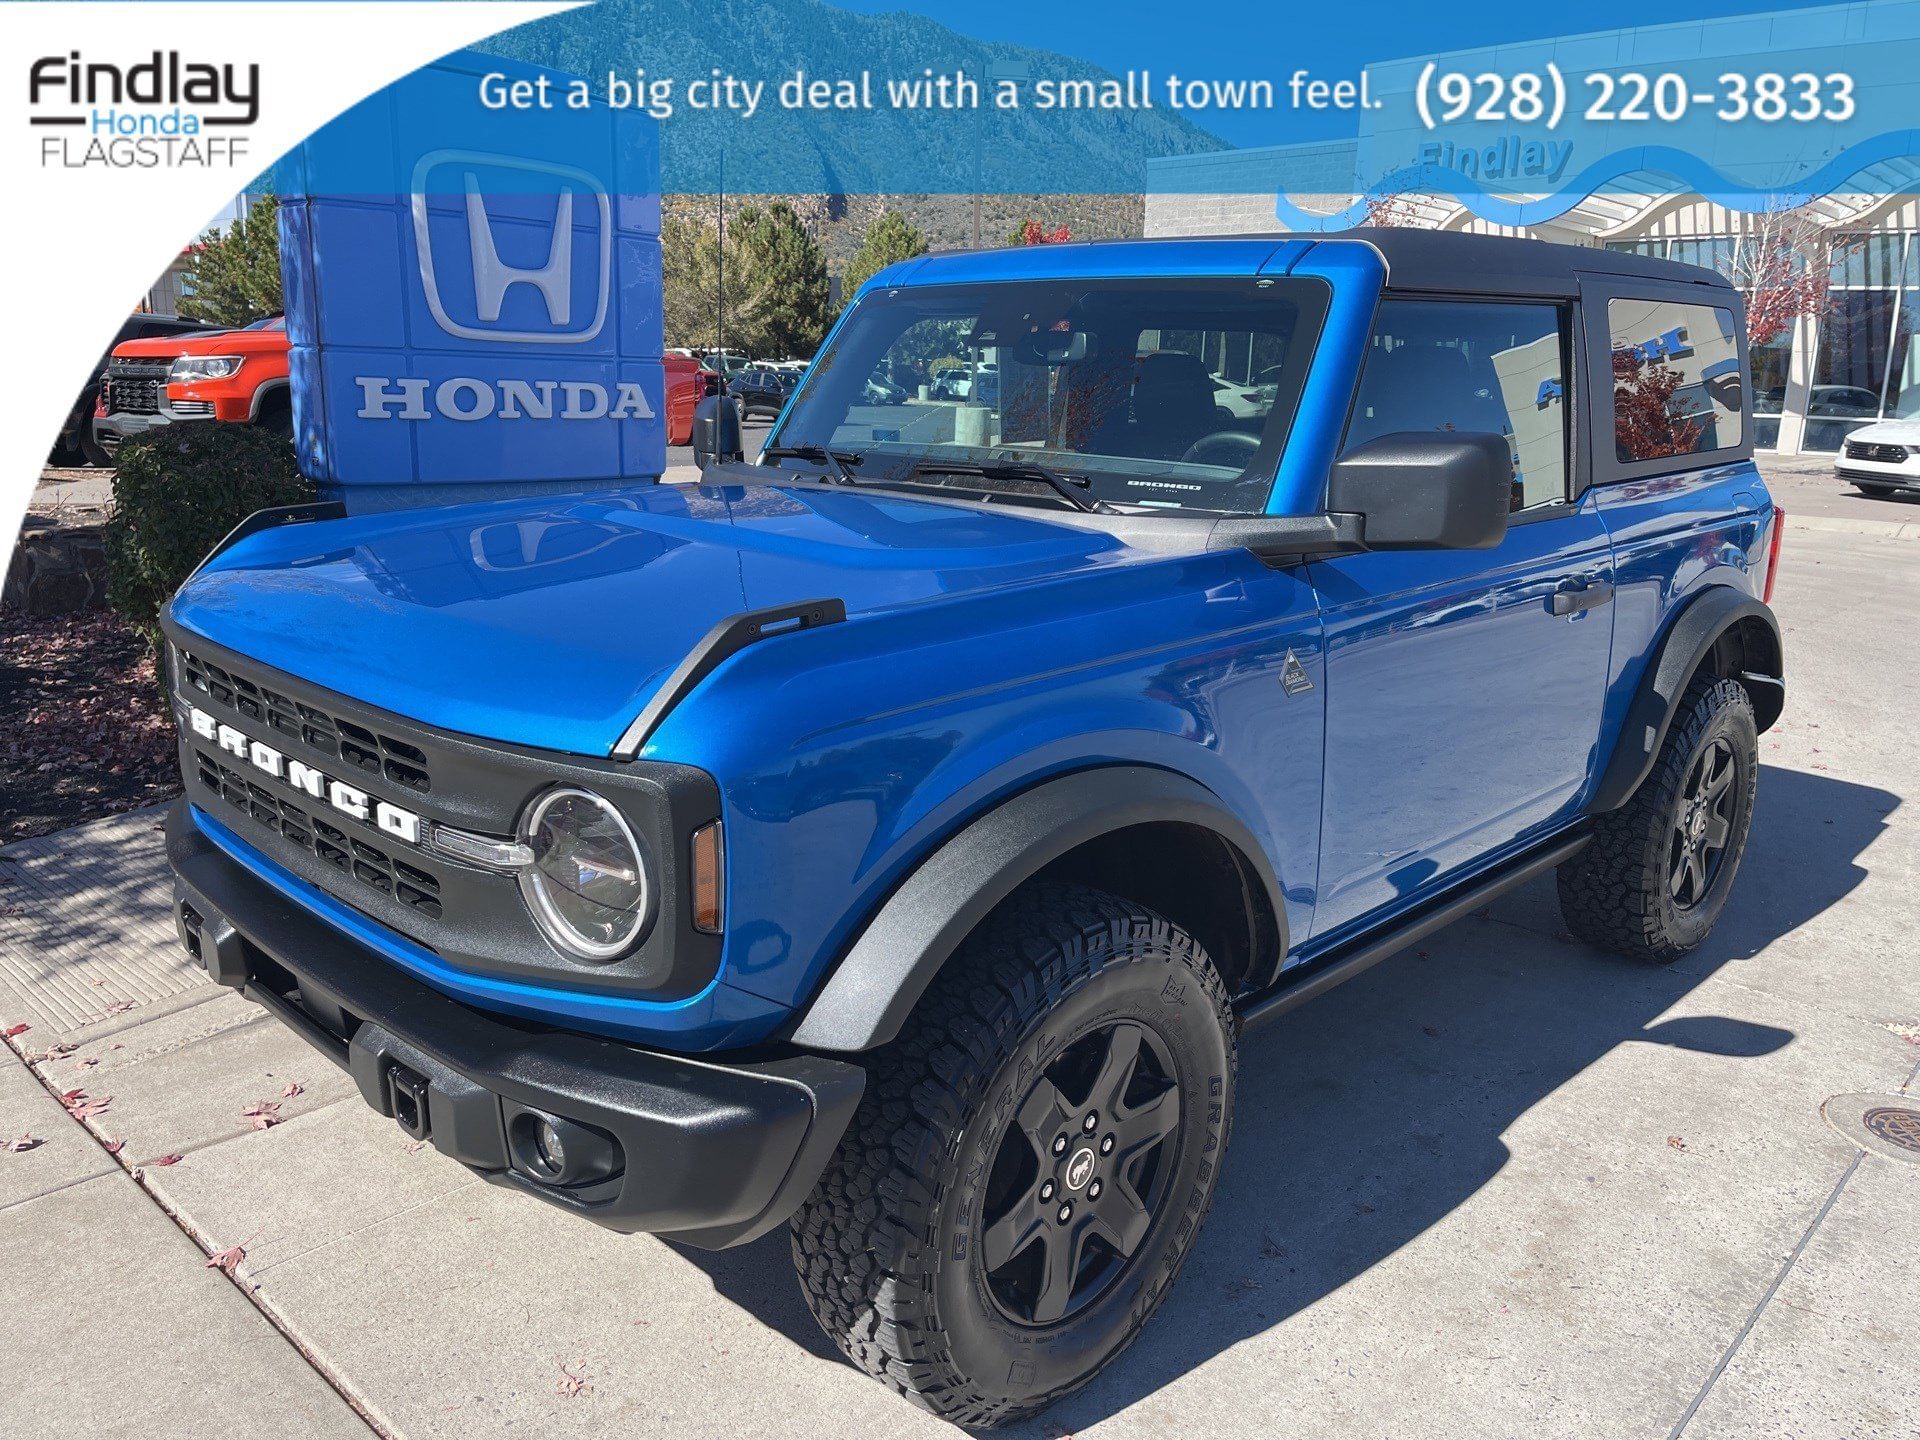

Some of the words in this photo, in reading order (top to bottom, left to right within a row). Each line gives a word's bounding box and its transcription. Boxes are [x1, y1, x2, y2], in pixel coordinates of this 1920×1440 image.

[1419, 134, 1574, 184] Findlay
[355, 375, 656, 422] HONDA
[1127, 480, 1202, 491] BRONCO
[190, 707, 421, 844] BRONCO
[952, 1033, 1057, 1262] GENERAL
[1161, 1074, 1224, 1273] GRABBER
